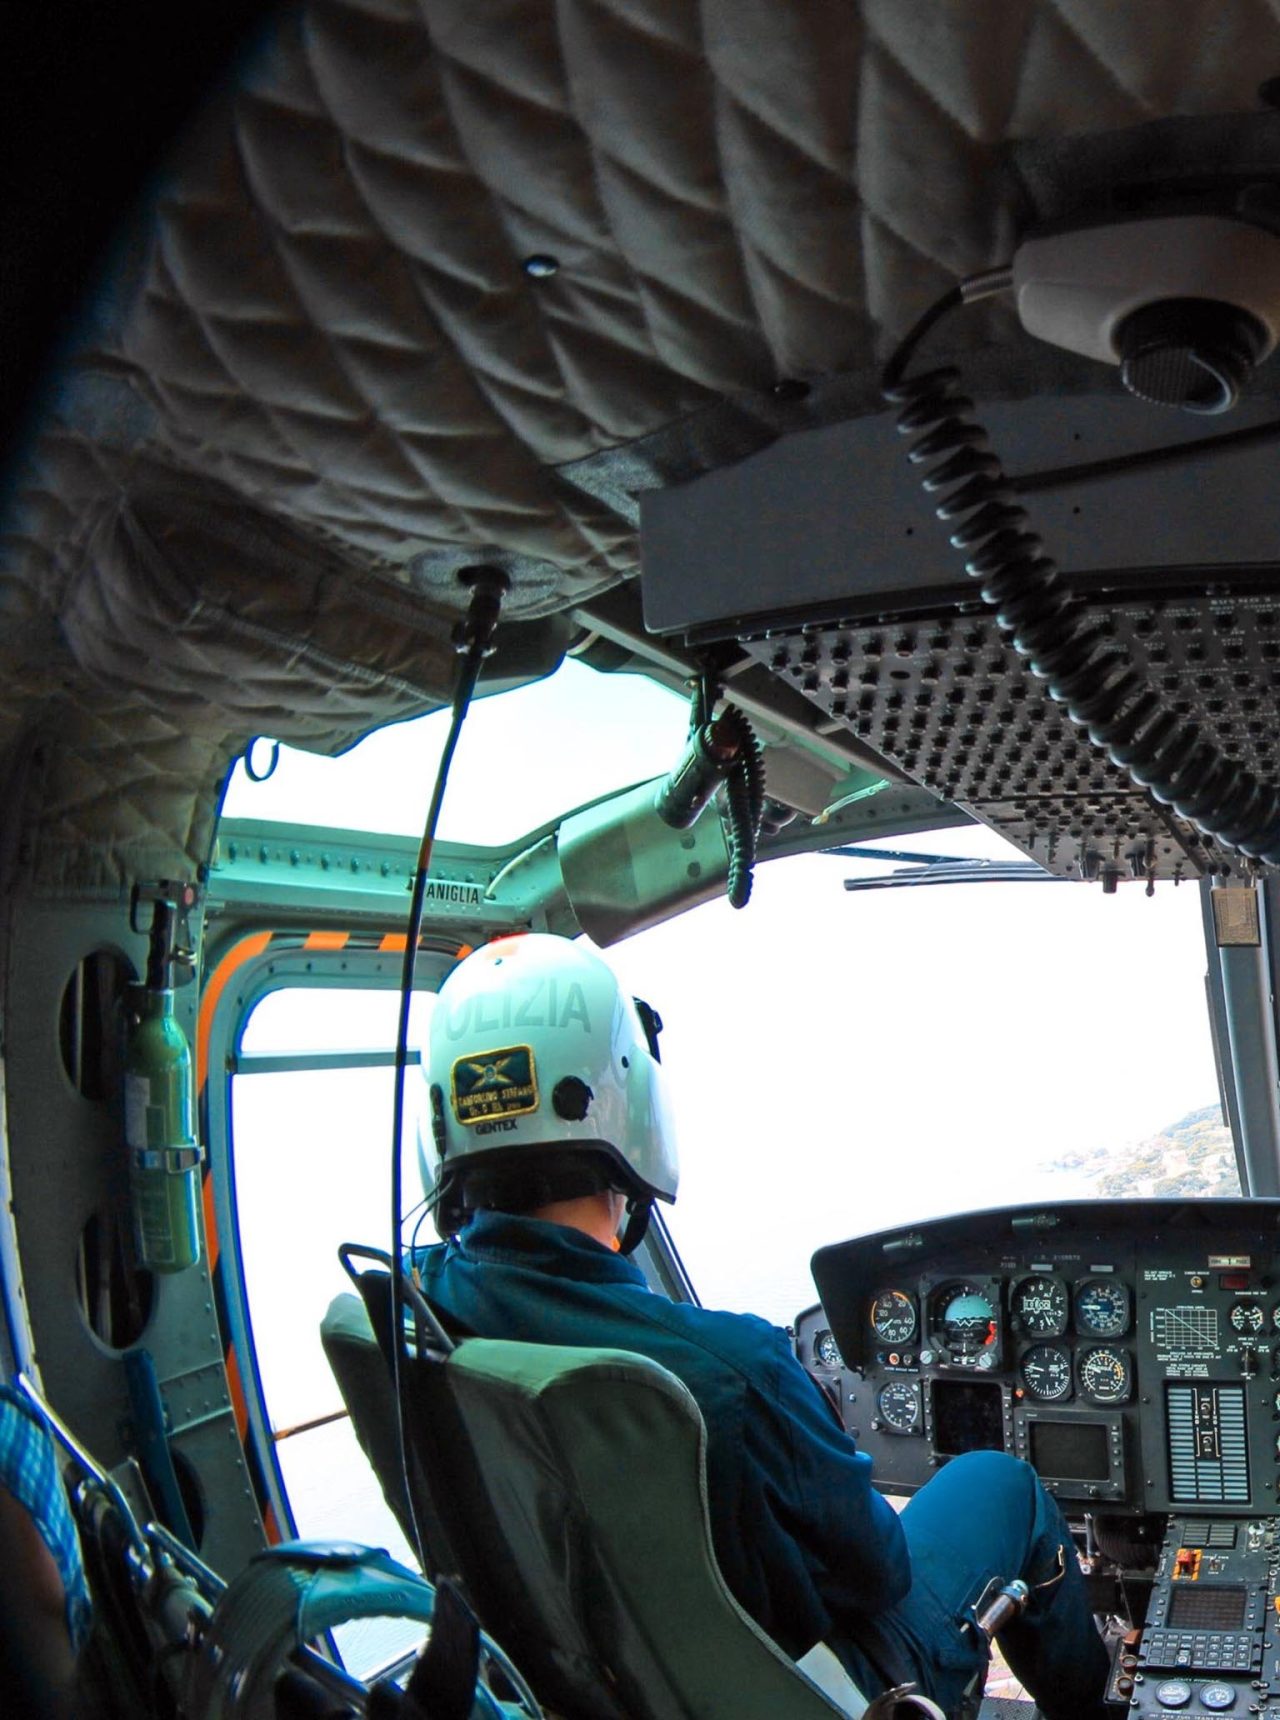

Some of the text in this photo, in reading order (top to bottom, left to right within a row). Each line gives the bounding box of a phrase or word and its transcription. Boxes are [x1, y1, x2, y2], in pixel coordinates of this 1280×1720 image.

[426, 882, 480, 904] ANIGLIA
[444, 977, 592, 1042] OLIZIA
[475, 1119, 518, 1135] GENTEX
